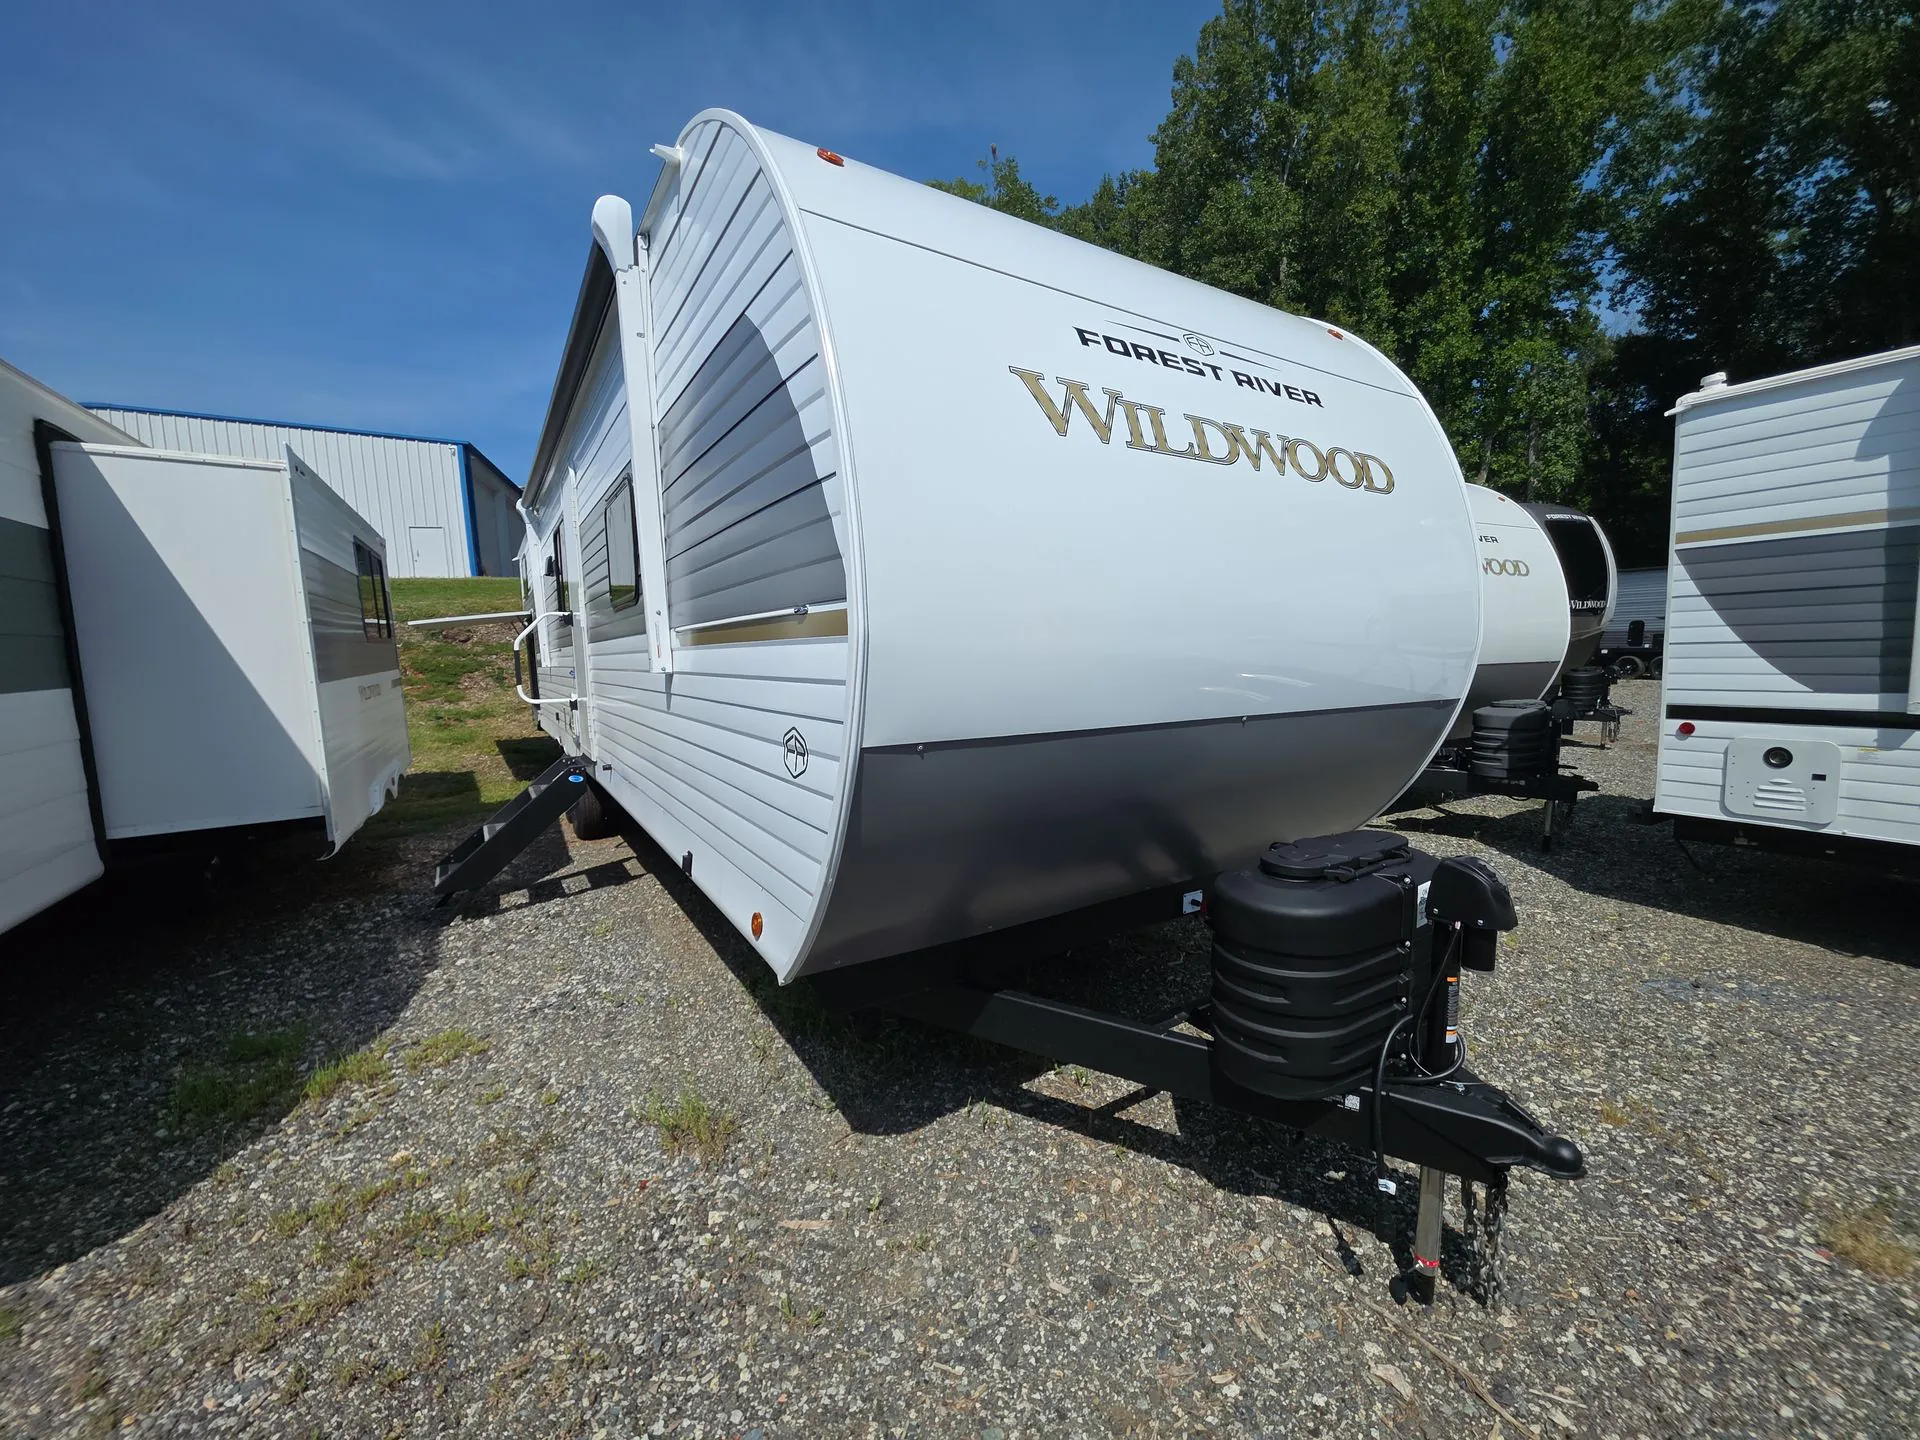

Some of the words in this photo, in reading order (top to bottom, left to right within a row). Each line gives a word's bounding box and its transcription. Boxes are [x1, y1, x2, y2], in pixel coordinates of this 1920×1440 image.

[1073, 326, 1224, 382] FOREST
[1230, 369, 1325, 408] RIVER
[1008, 365, 1396, 495] WILDWOOD
